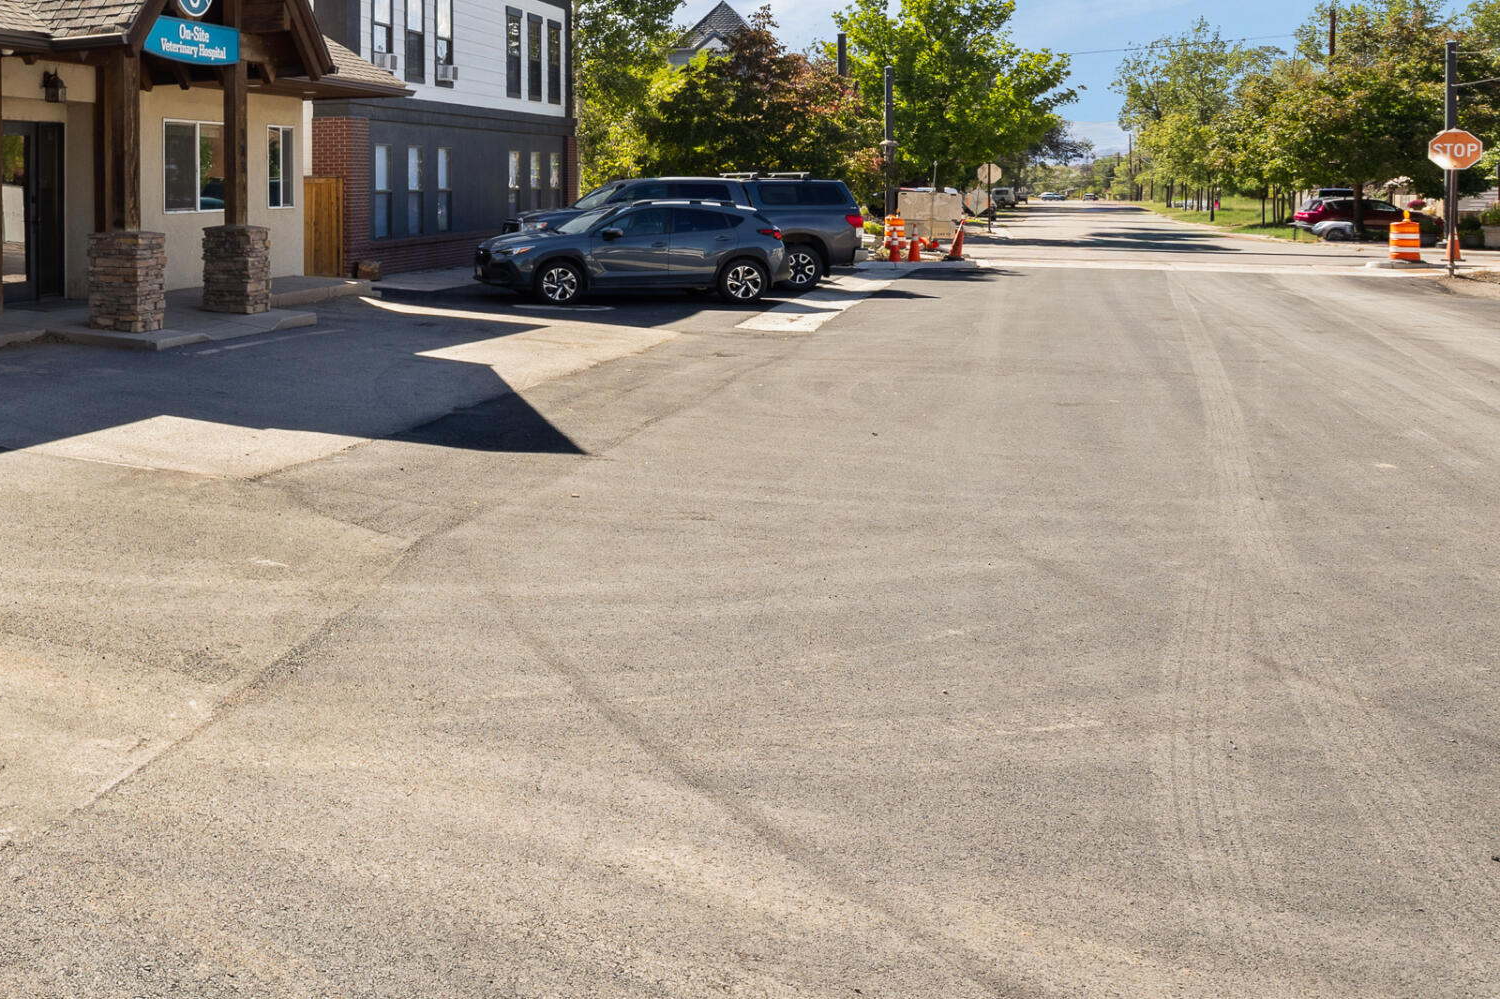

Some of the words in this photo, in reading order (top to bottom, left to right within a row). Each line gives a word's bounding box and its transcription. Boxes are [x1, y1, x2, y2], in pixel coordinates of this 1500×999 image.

[179, 23, 210, 43] On-Site
[160, 37, 198, 58] Veterinary
[198, 43, 227, 61] Hospital
[1433, 143, 1478, 158] STOP
